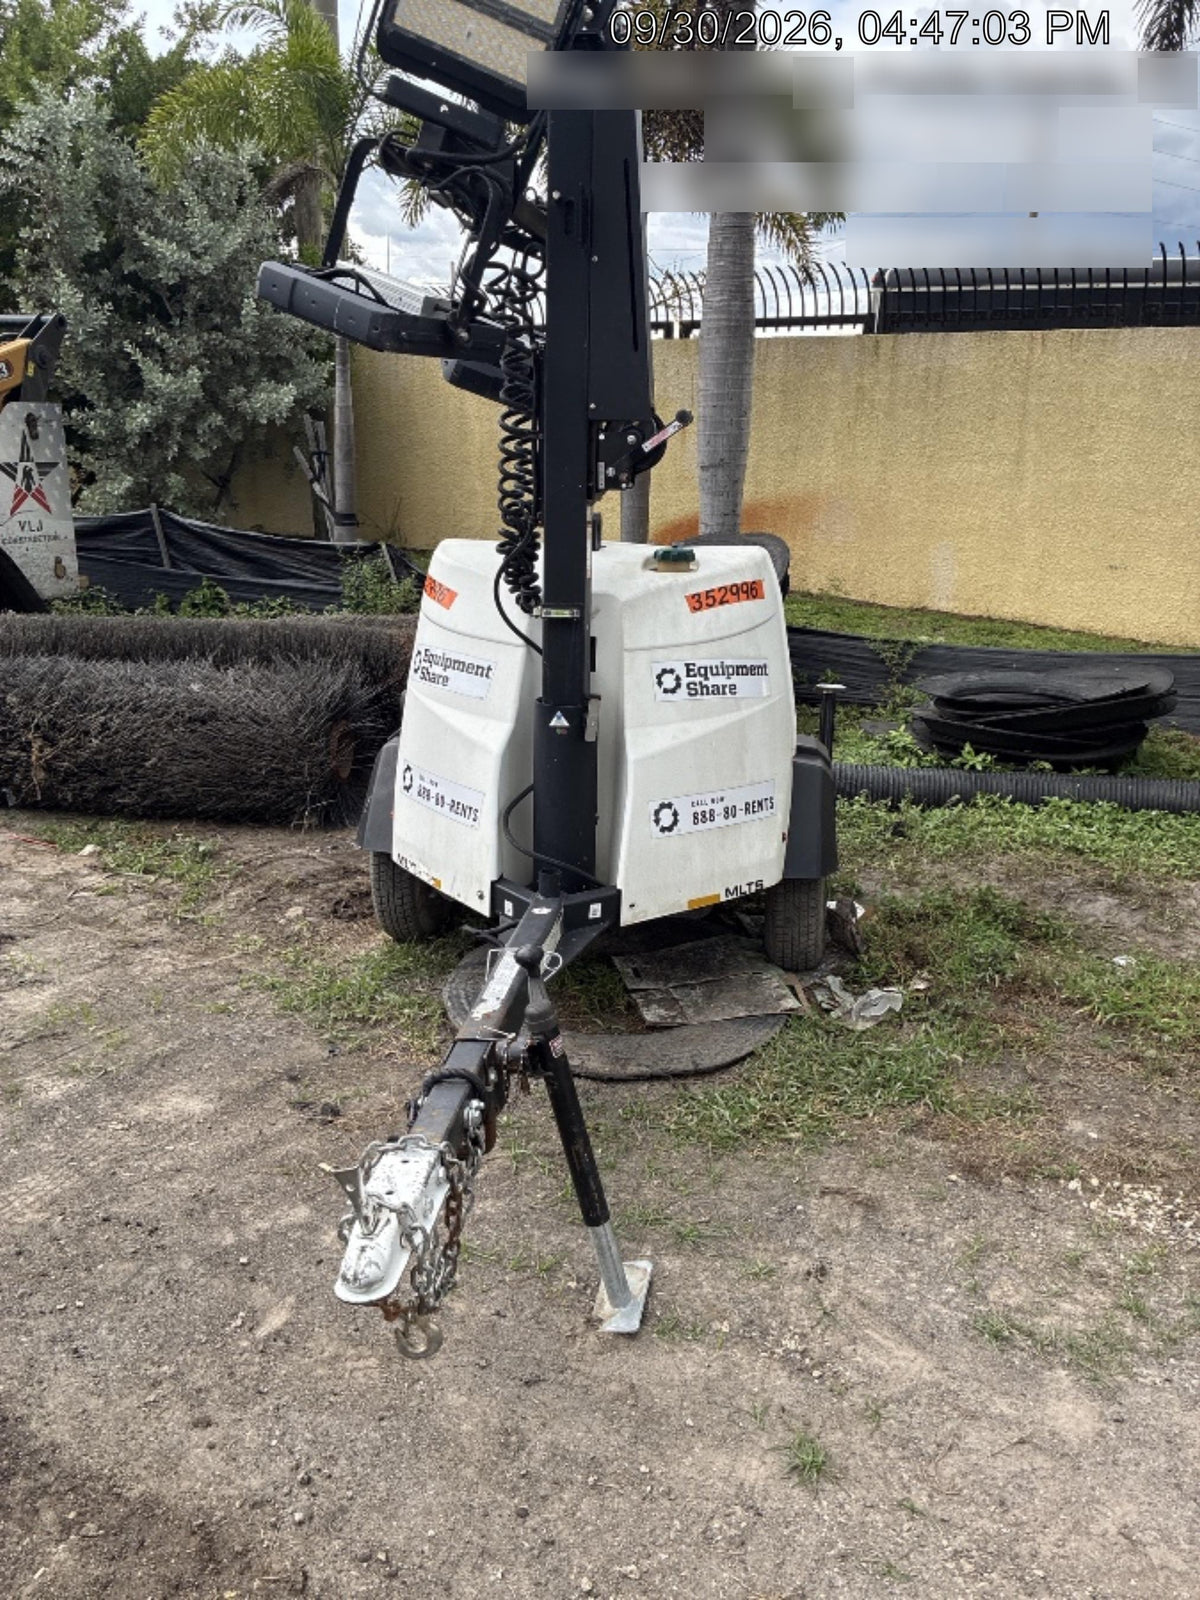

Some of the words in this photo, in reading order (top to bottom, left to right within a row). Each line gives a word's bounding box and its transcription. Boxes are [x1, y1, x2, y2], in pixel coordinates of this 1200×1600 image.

[690, 580, 759, 612] 352996
[422, 648, 493, 680] Equipment
[684, 660, 769, 681] Equipment
[418, 666, 449, 687] Share
[685, 680, 738, 697] Share
